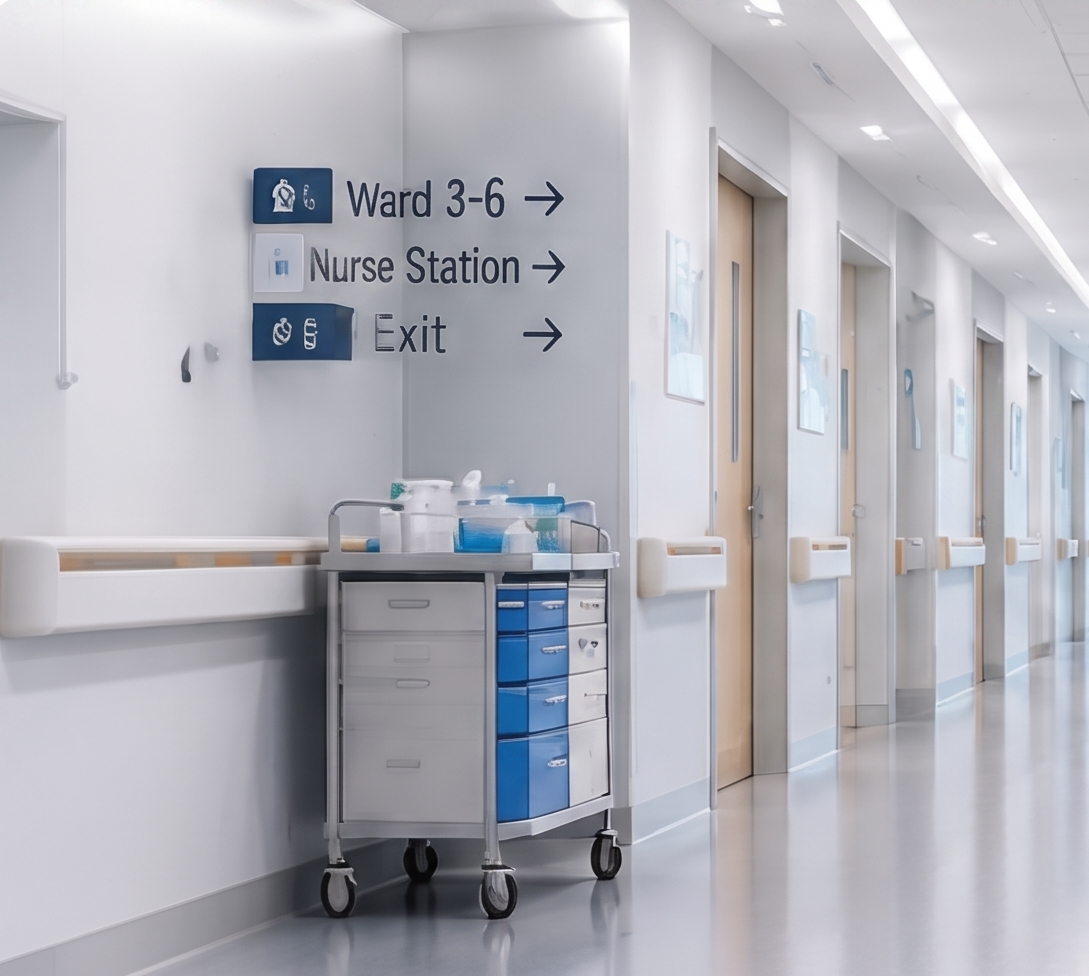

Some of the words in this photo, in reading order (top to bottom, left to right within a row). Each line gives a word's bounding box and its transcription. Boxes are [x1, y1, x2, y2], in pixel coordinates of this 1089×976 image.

[346, 179, 432, 218] Ward
[446, 176, 505, 218] 3-6
[310, 247, 395, 283] Nurse
[405, 245, 520, 285] Station
[374, 313, 447, 354] Exit
